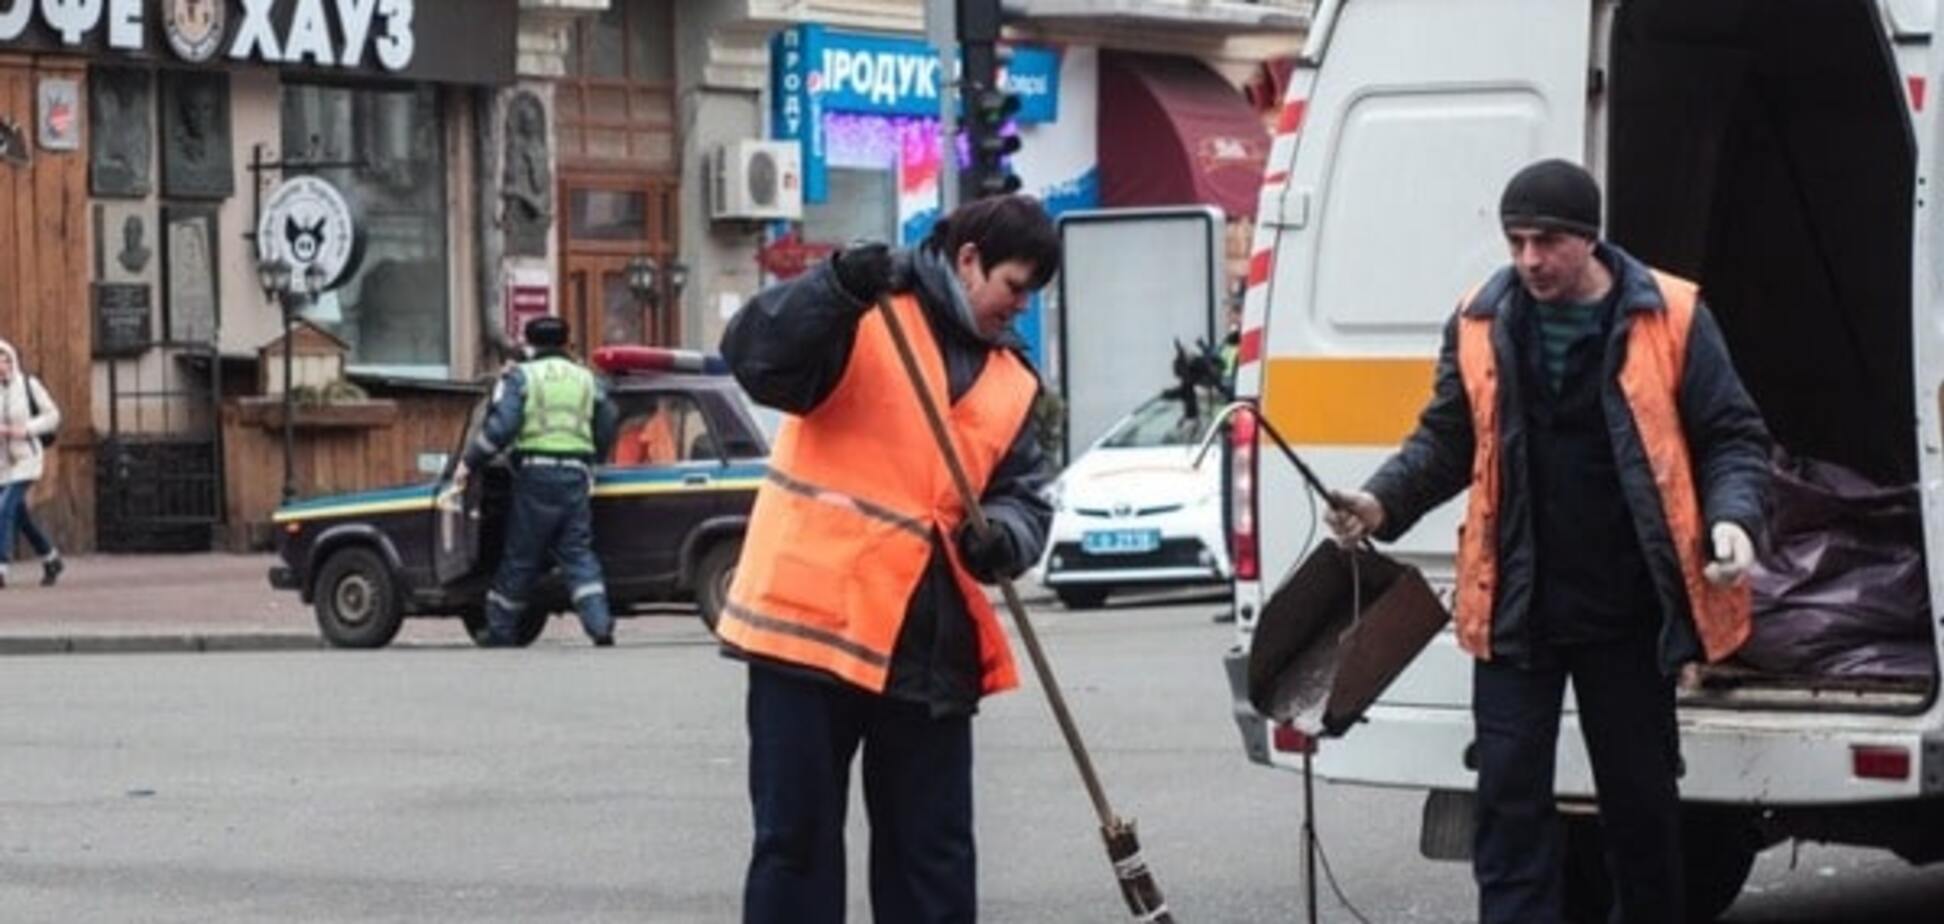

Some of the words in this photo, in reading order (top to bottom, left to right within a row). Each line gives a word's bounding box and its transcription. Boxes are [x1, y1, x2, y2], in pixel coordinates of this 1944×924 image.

[0, 0, 144, 49] ФЕ
[229, 0, 415, 70] ХАУЗ
[822, 48, 961, 104] РОДУК
